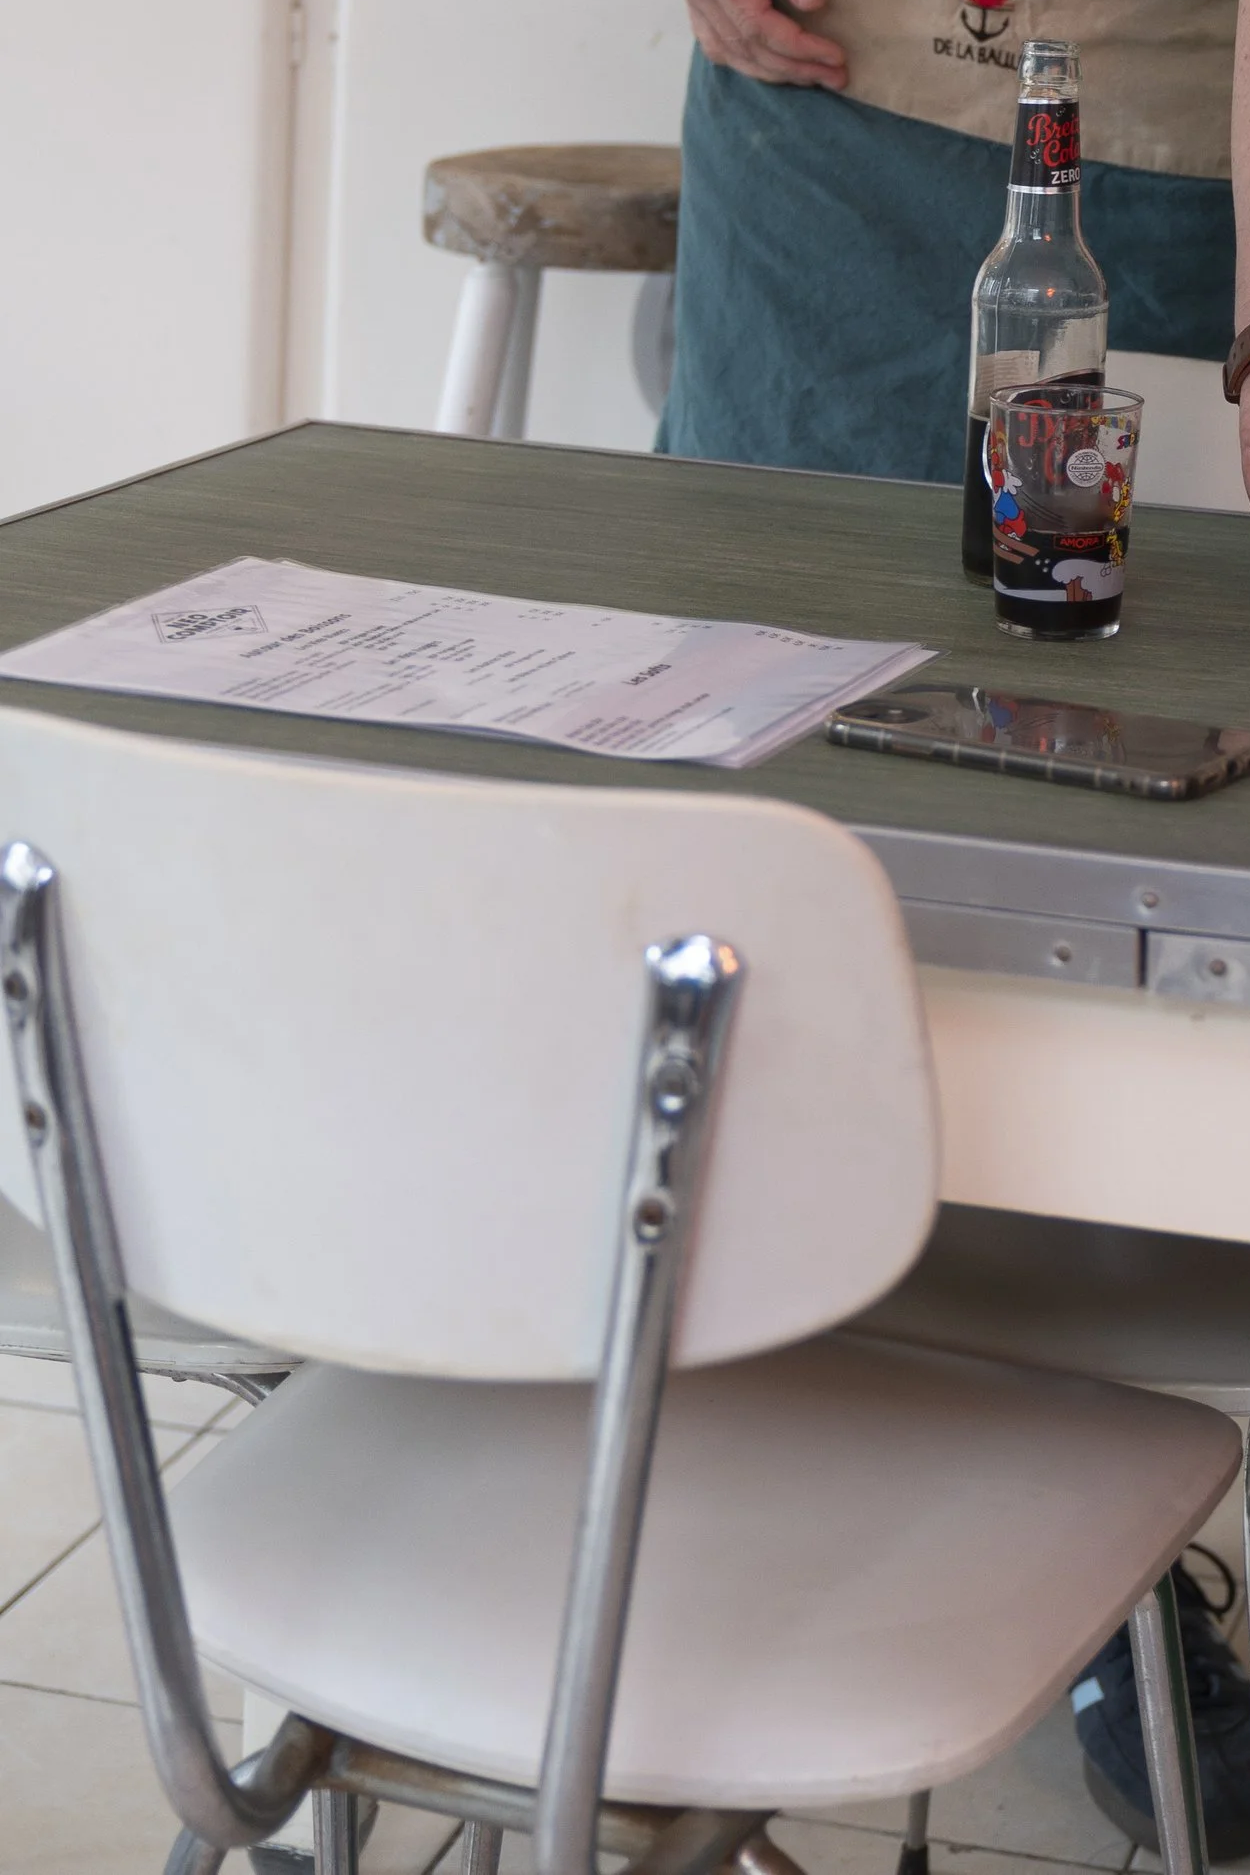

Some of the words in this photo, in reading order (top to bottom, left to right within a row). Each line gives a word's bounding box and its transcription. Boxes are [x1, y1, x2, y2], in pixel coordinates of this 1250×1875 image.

[933, 38, 952, 56] DE
[956, 43, 974, 61] LA
[977, 47, 1019, 71] BAUL
[1051, 167, 1080, 185] ZERO
[1060, 536, 1099, 549] AMORA
[166, 607, 254, 640] COMPTOIR
[167, 613, 208, 629] NEO
